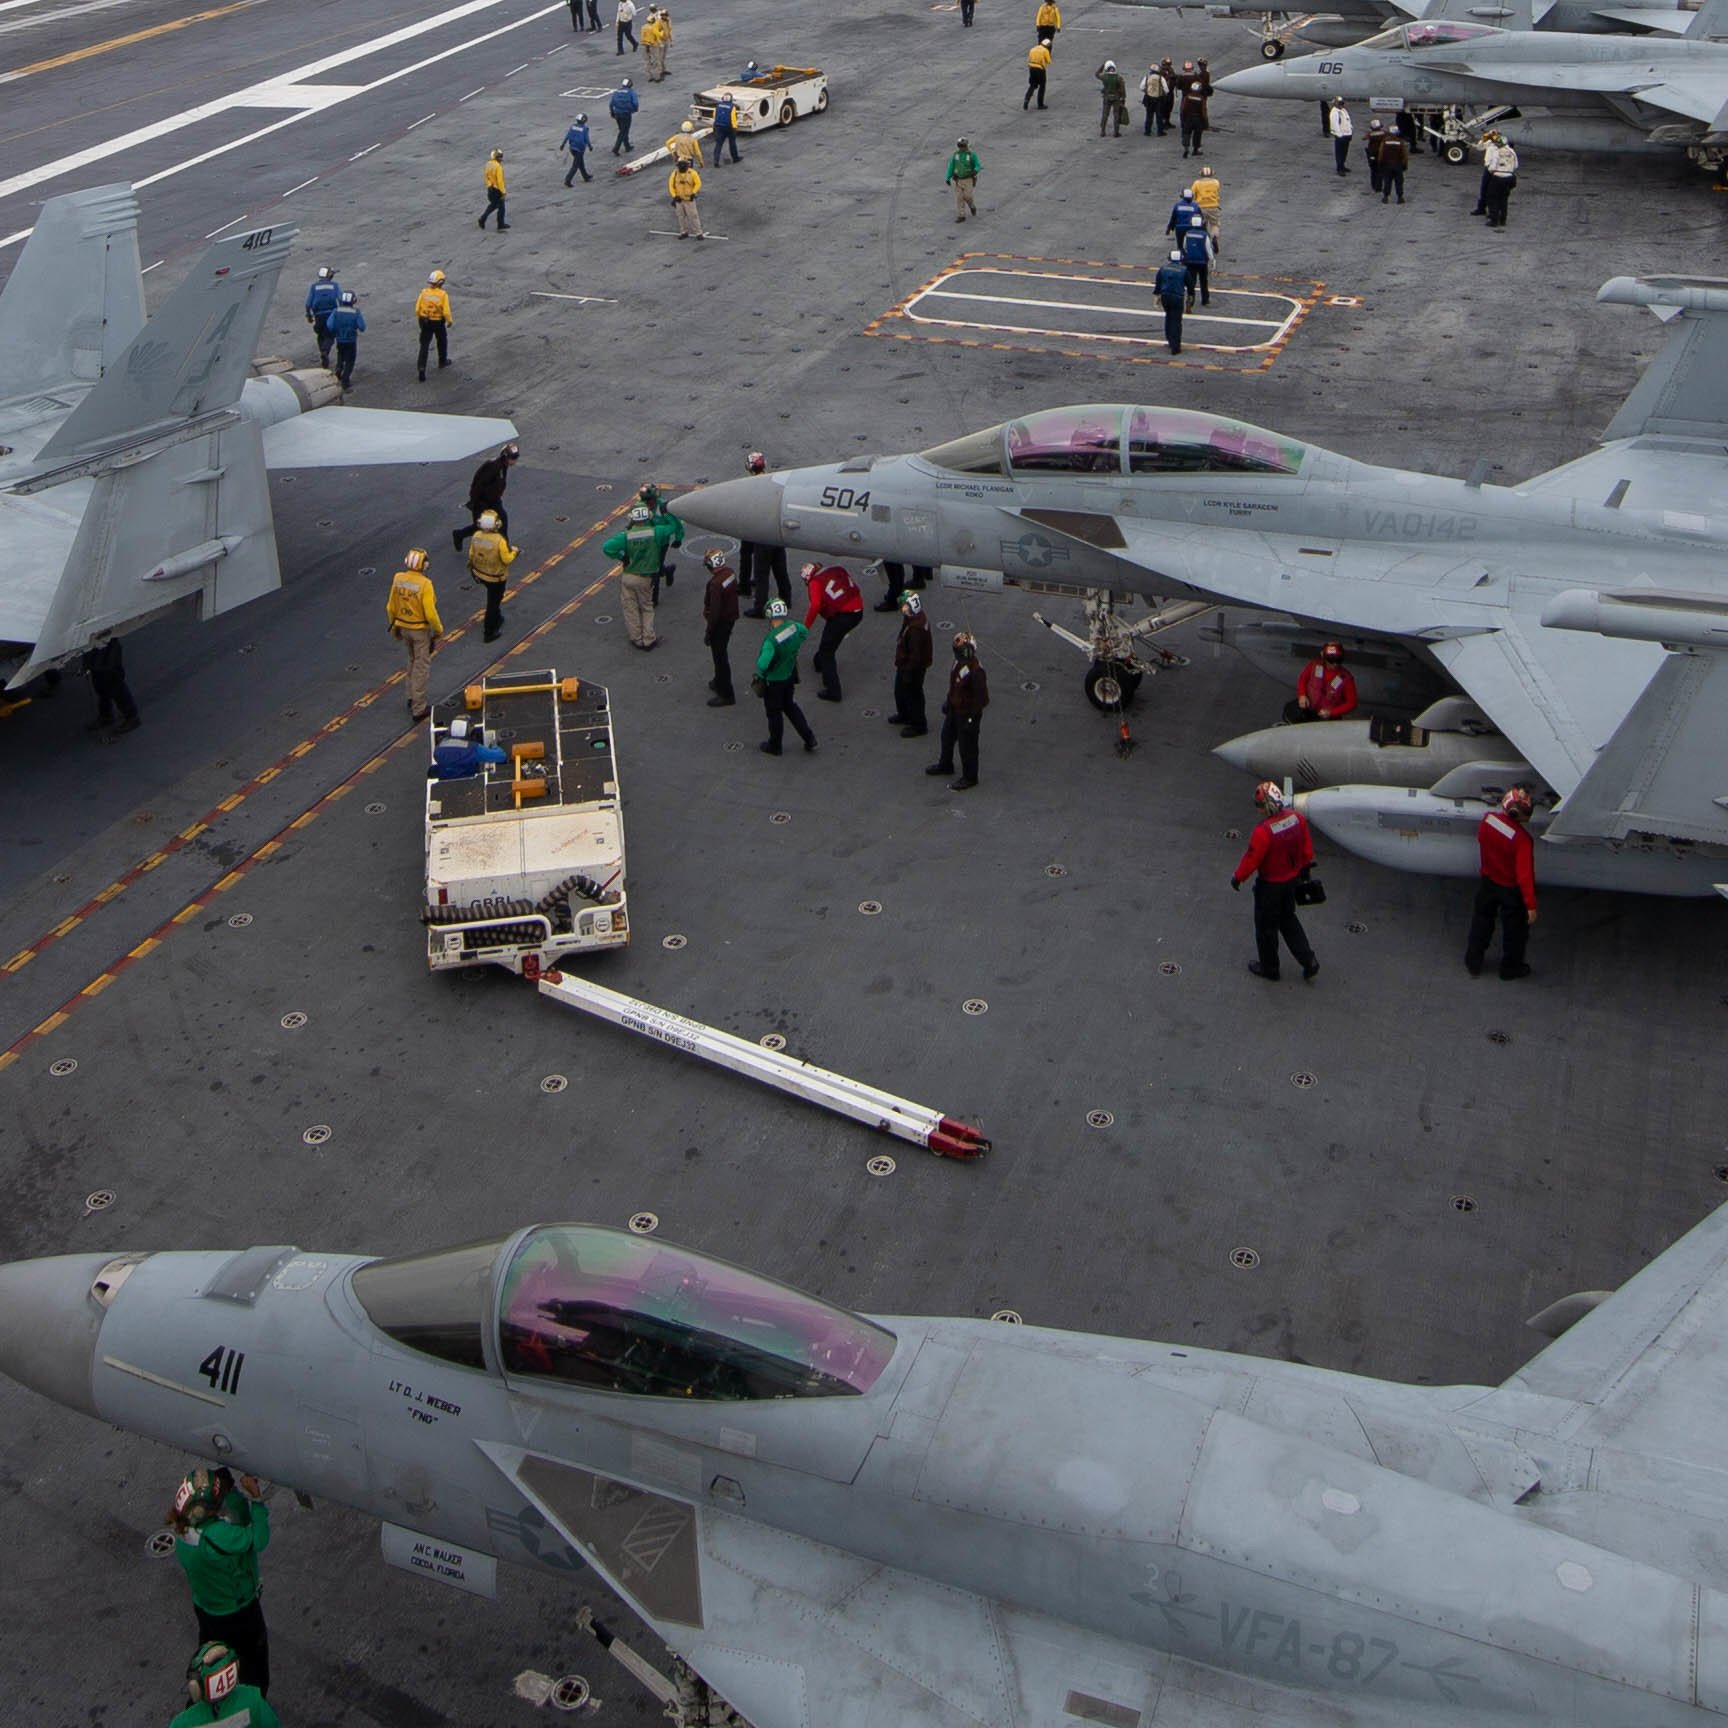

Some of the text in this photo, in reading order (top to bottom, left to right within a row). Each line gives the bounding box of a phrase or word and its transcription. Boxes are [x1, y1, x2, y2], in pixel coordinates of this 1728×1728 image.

[1318, 61, 1344, 75] 106
[242, 228, 273, 251] 410
[820, 486, 871, 512] 504
[1363, 510, 1479, 542] VAQ-142
[198, 1344, 245, 1395] 411
[389, 1380, 403, 1393] LT
[426, 1394, 461, 1417] WEBER
[413, 1542, 425, 1555] AN
[433, 1548, 464, 1567] WALKER
[1220, 1602, 1400, 1686] VFA-87
[215, 1668, 236, 1694] 4E
